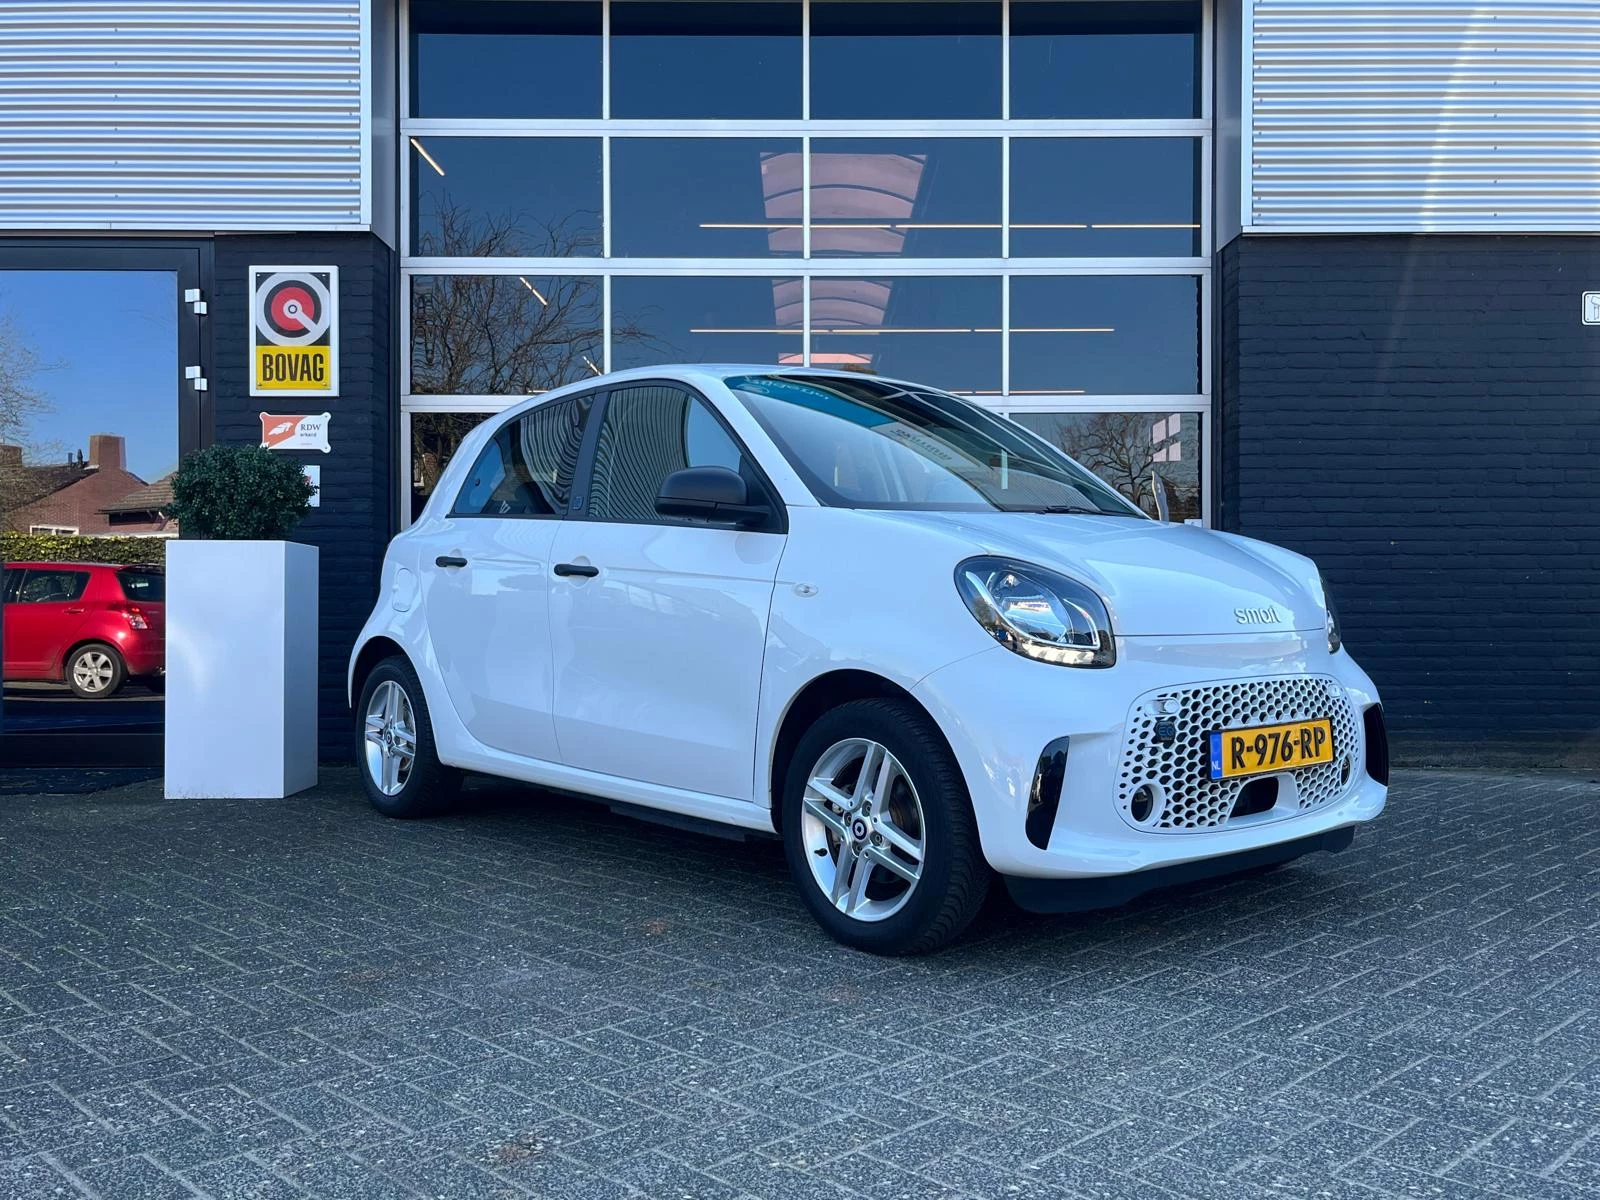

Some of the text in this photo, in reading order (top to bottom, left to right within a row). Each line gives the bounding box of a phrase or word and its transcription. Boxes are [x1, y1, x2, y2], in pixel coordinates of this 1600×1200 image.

[262, 353, 324, 382] BOVAG
[300, 423, 321, 432] RDW
[1233, 605, 1281, 624] smart
[1211, 727, 1325, 771] NL R-976-RP
